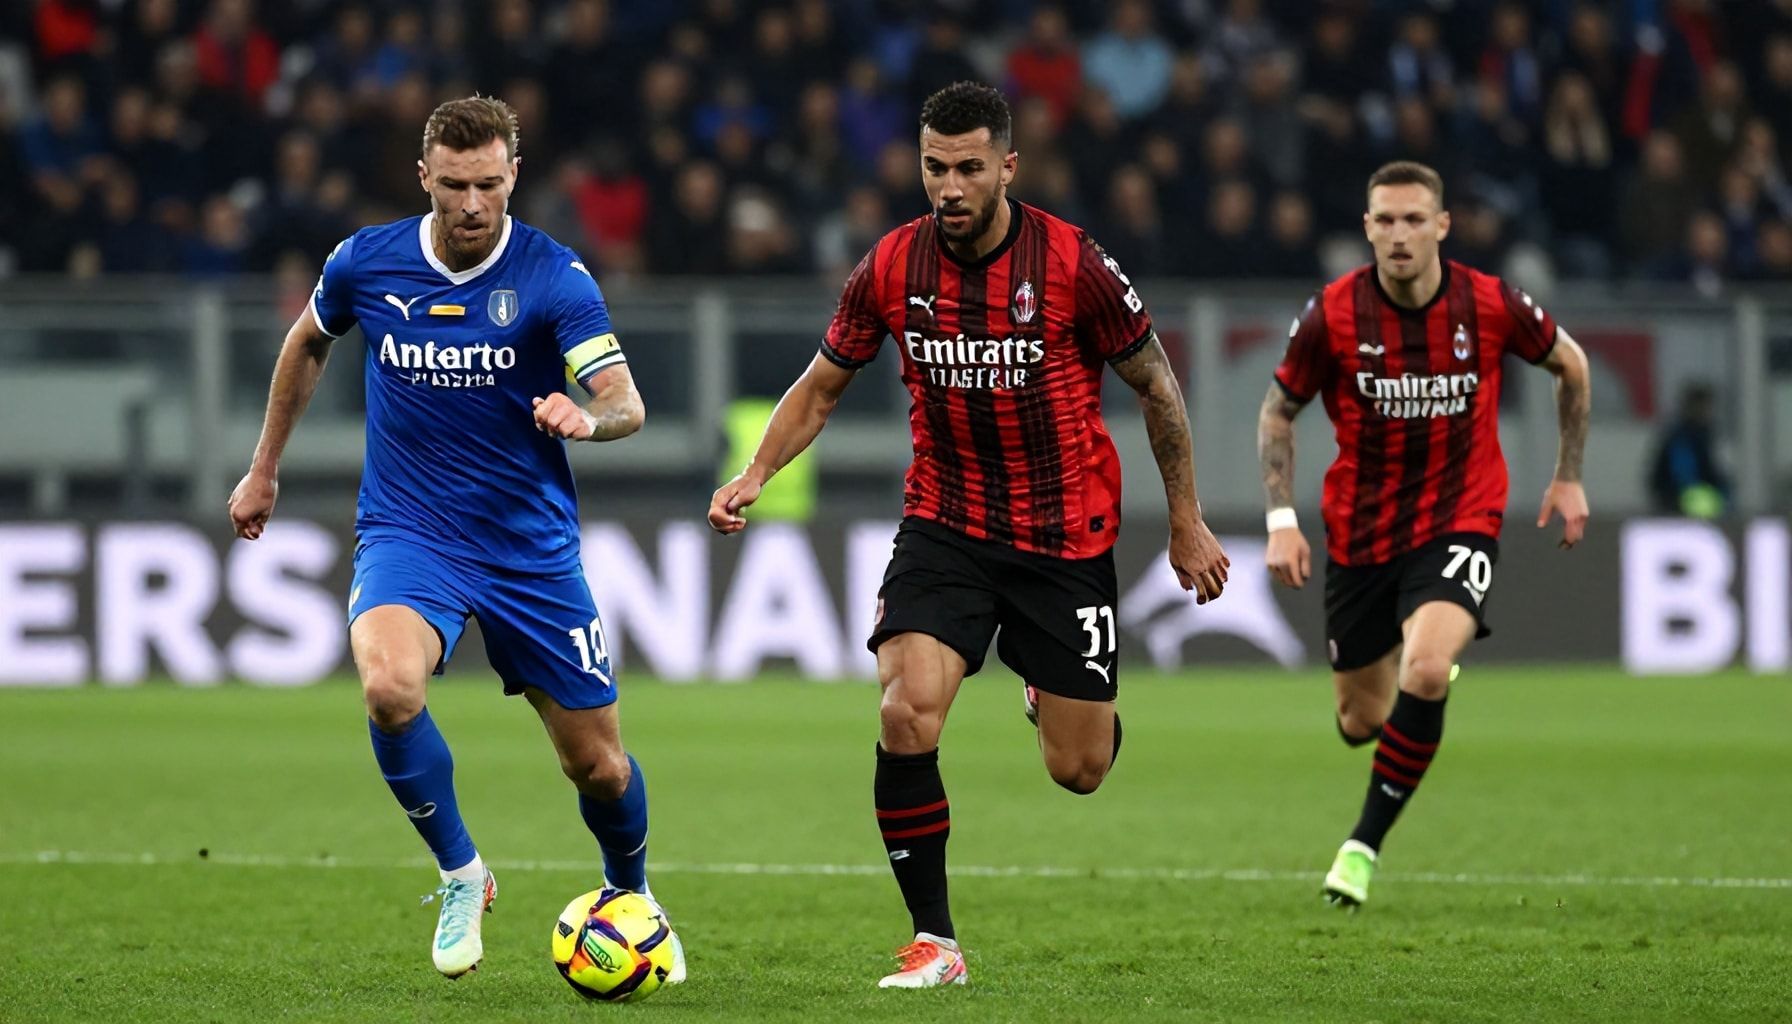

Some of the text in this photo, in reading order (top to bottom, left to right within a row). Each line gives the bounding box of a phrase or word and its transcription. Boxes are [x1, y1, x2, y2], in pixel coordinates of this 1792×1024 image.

[1441, 545, 1493, 592] 70
[0, 521, 346, 686] ERS
[1076, 605, 1117, 658] 31
